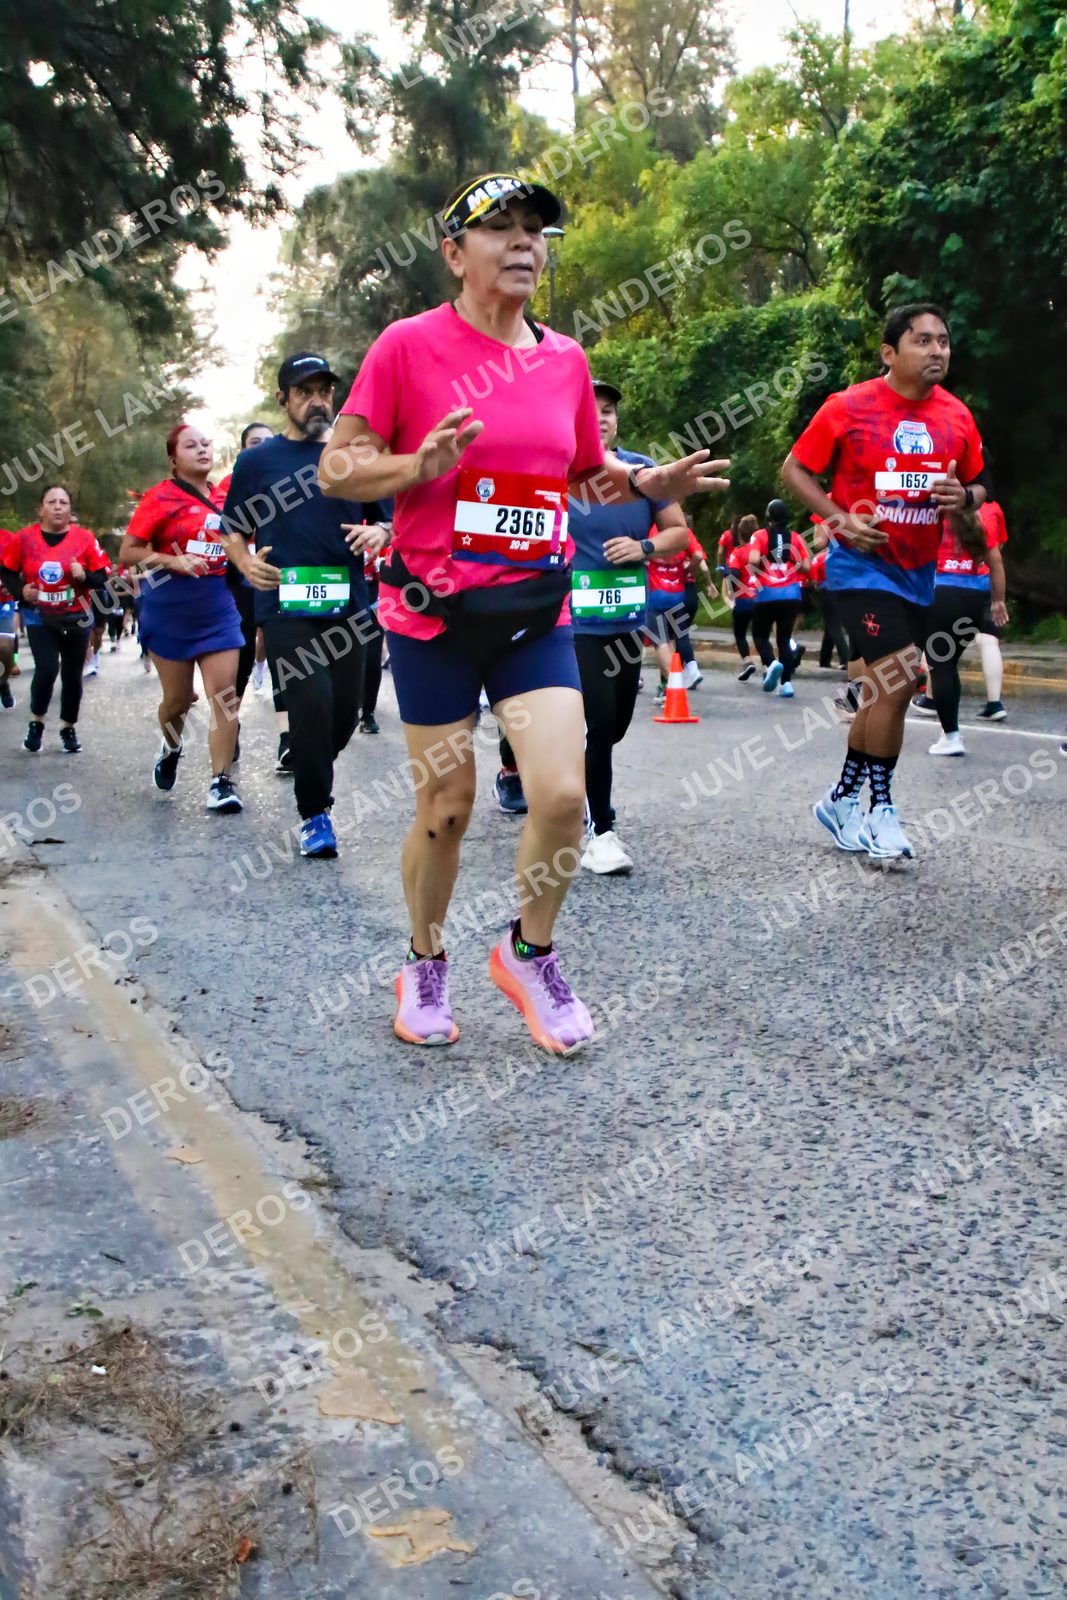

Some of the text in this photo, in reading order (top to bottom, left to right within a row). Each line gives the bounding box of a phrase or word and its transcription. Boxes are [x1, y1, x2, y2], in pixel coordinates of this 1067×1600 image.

[900, 473, 928, 489] 1652
[495, 507, 545, 537] 2366
[306, 585, 327, 599] 765
[598, 589, 621, 605] 766
